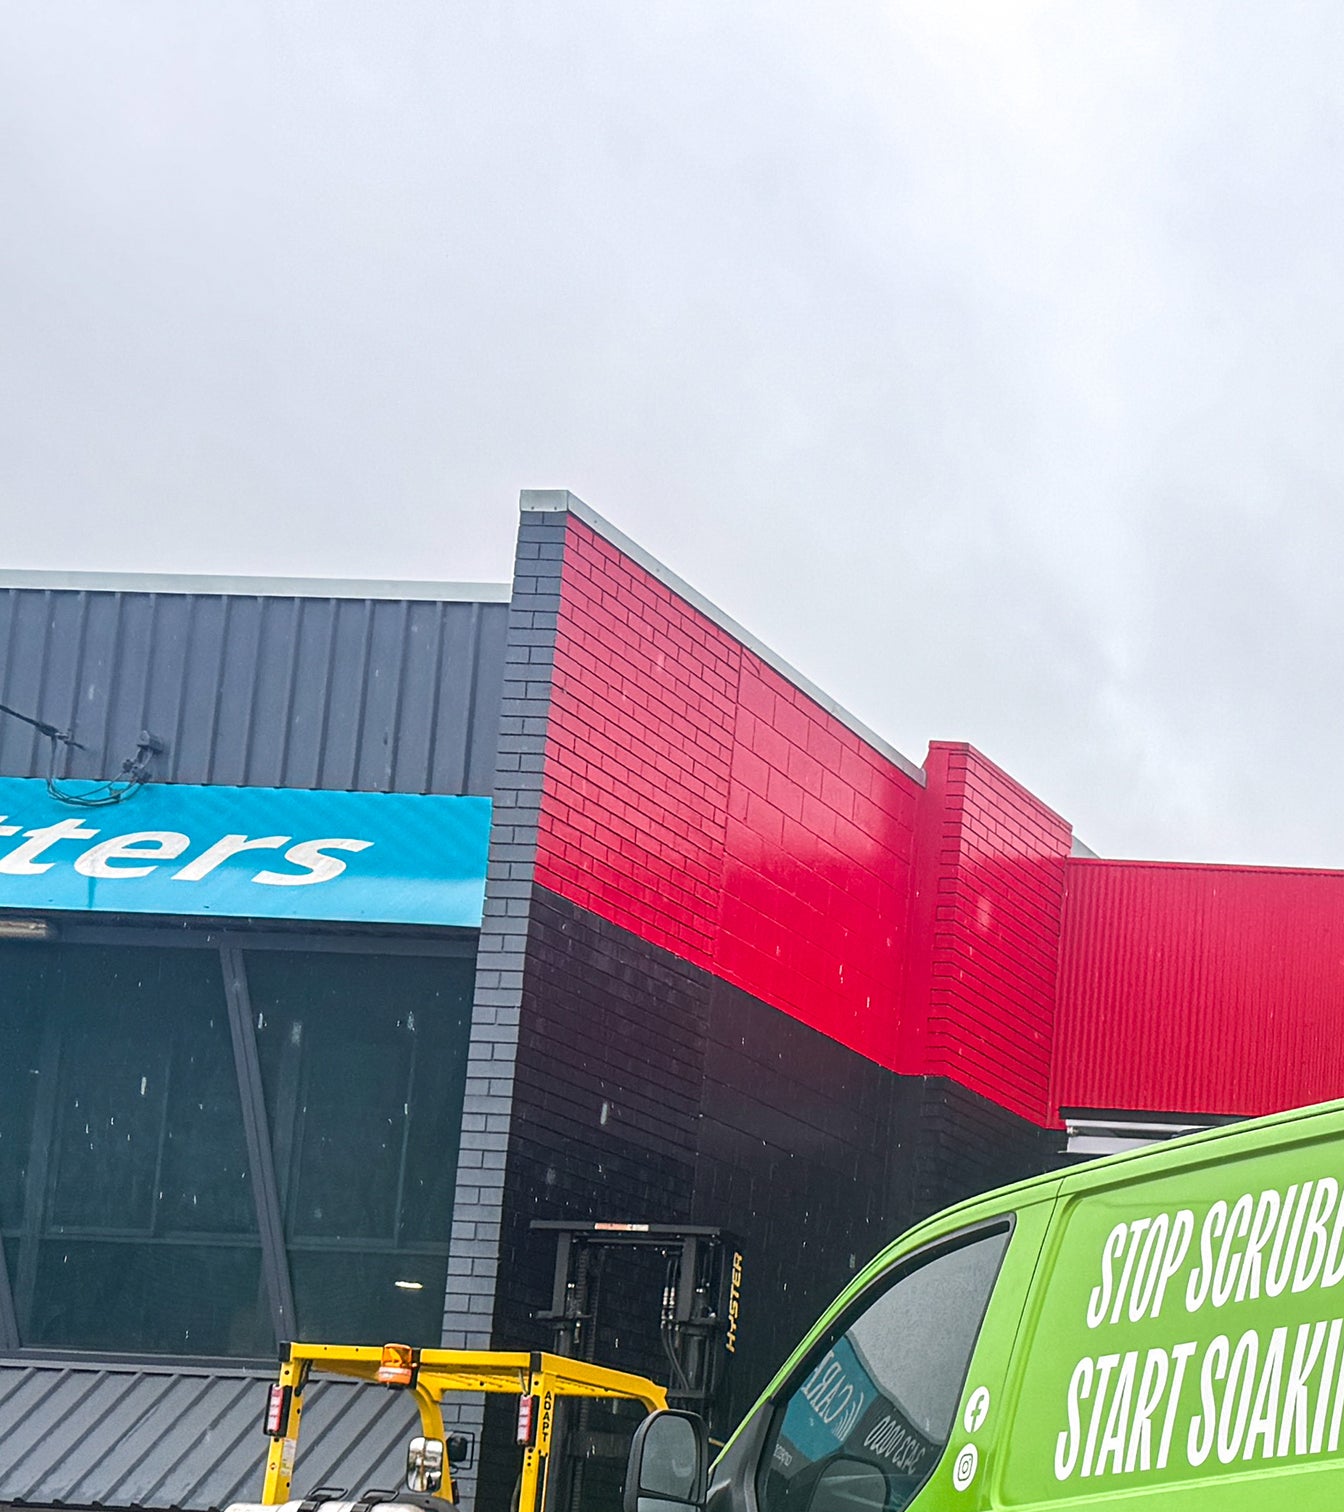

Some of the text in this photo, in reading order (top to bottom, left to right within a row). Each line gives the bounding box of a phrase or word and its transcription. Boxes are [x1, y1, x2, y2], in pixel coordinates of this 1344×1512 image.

[0, 815, 375, 886] ters
[726, 1251, 744, 1353] HYSTER
[1086, 1207, 1195, 1329] STOP
[542, 1391, 552, 1444] ADAPT
[1053, 1340, 1197, 1482] START
